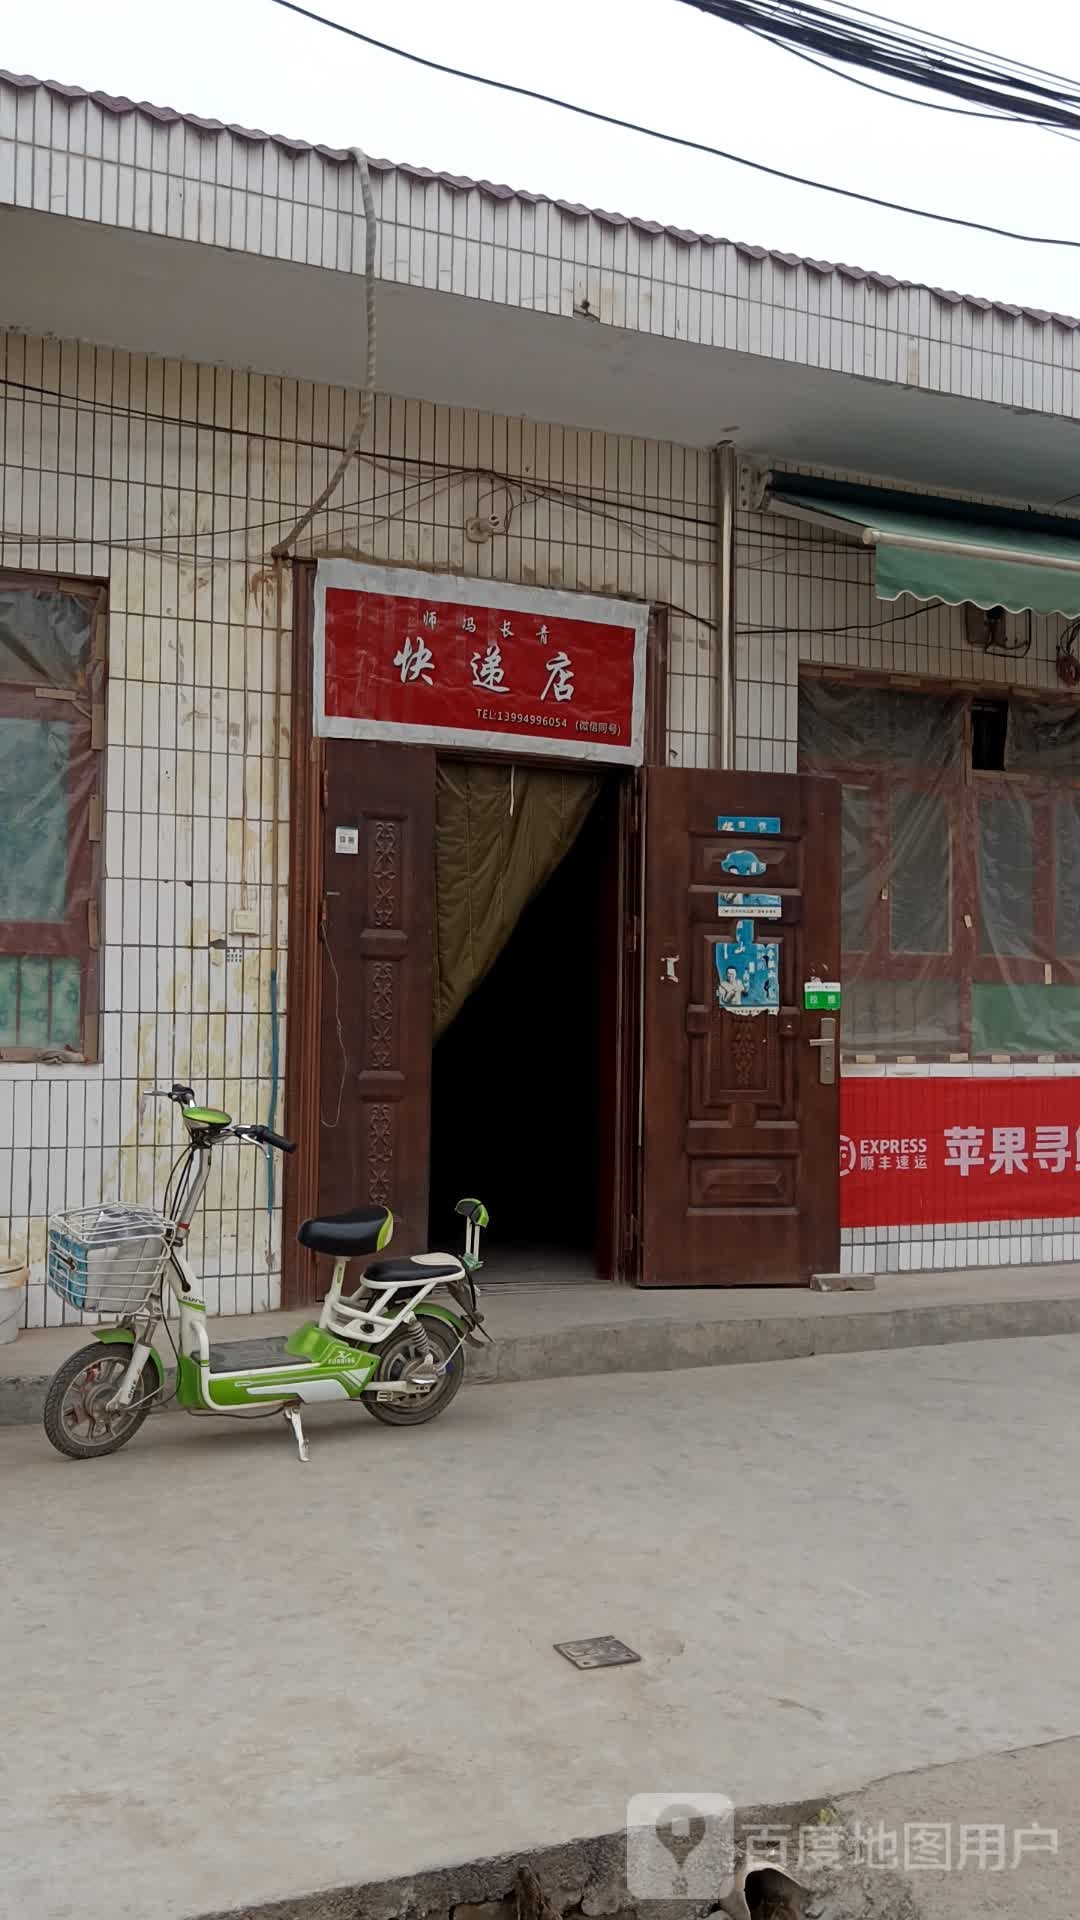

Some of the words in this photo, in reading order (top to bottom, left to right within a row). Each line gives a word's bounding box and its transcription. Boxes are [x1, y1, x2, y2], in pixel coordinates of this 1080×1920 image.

[393, 636, 575, 702] 快递店
[476, 708, 567, 728] TEL:13994996054
[860, 1138, 928, 1155] EXPRESS
[943, 1126, 1080, 1177] 苹果寻
[860, 1155, 928, 1171] 顺丰速运
